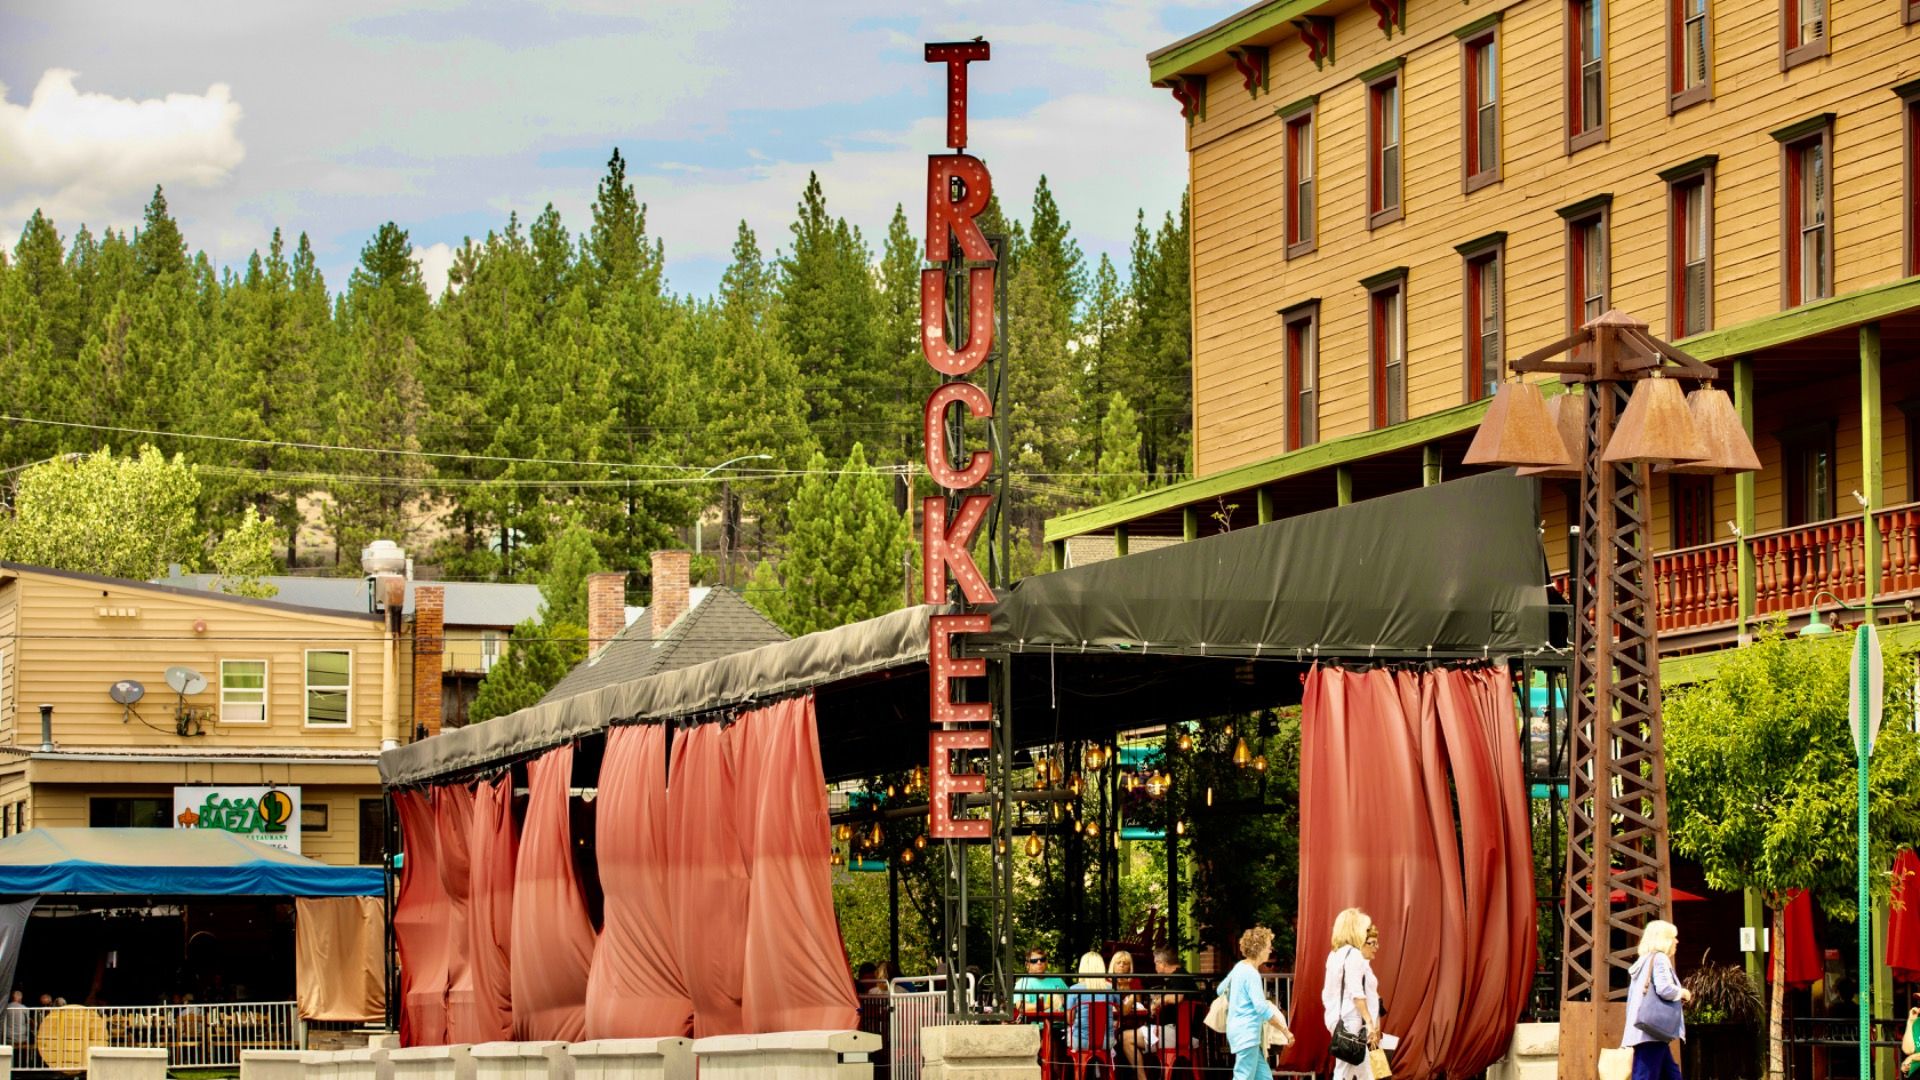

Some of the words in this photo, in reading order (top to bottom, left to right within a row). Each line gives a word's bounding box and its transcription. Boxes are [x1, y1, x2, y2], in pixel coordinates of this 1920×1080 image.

[921, 41, 998, 838] TRUCKEE
[206, 792, 258, 810] CASA
[199, 804, 266, 833] BAEZA
